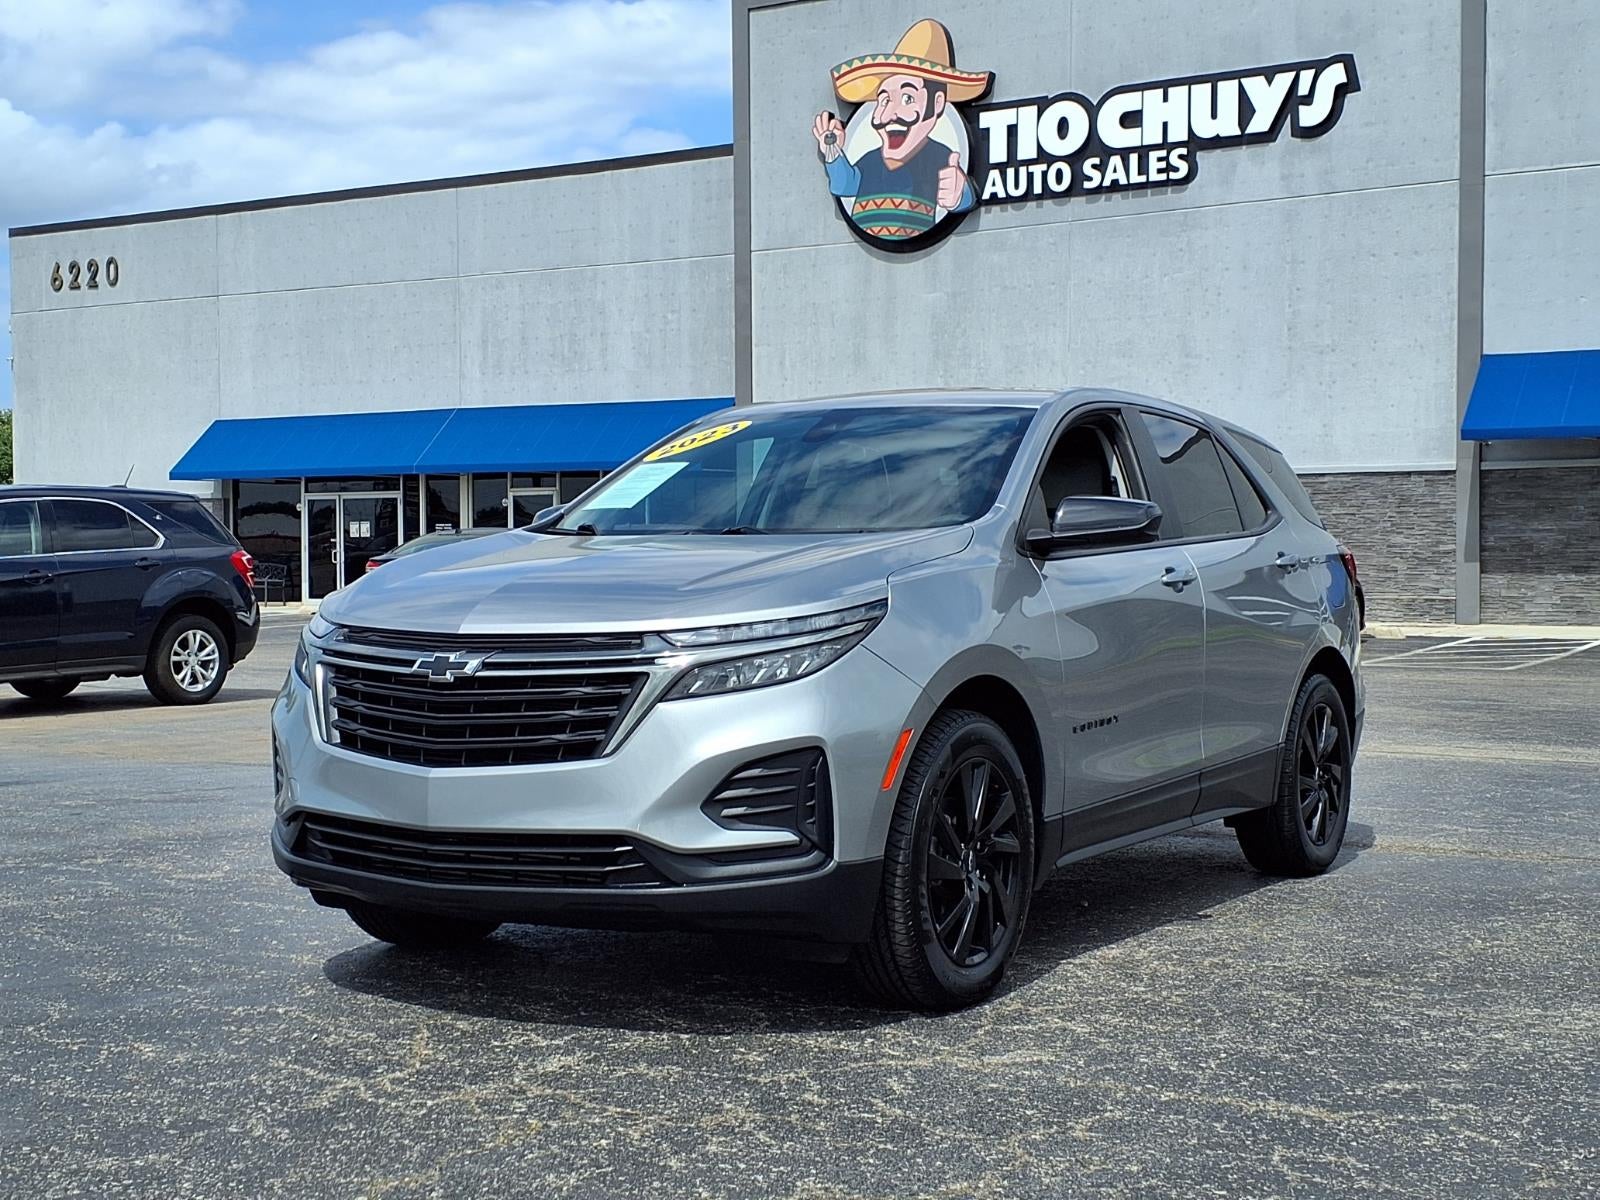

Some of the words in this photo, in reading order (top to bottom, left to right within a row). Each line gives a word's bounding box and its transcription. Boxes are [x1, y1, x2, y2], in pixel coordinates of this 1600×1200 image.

[979, 100, 1090, 164] TIO
[981, 161, 1072, 200] AUTO
[1082, 147, 1189, 189] SALES
[50, 256, 119, 293] 6220
[657, 424, 739, 457] 2023
